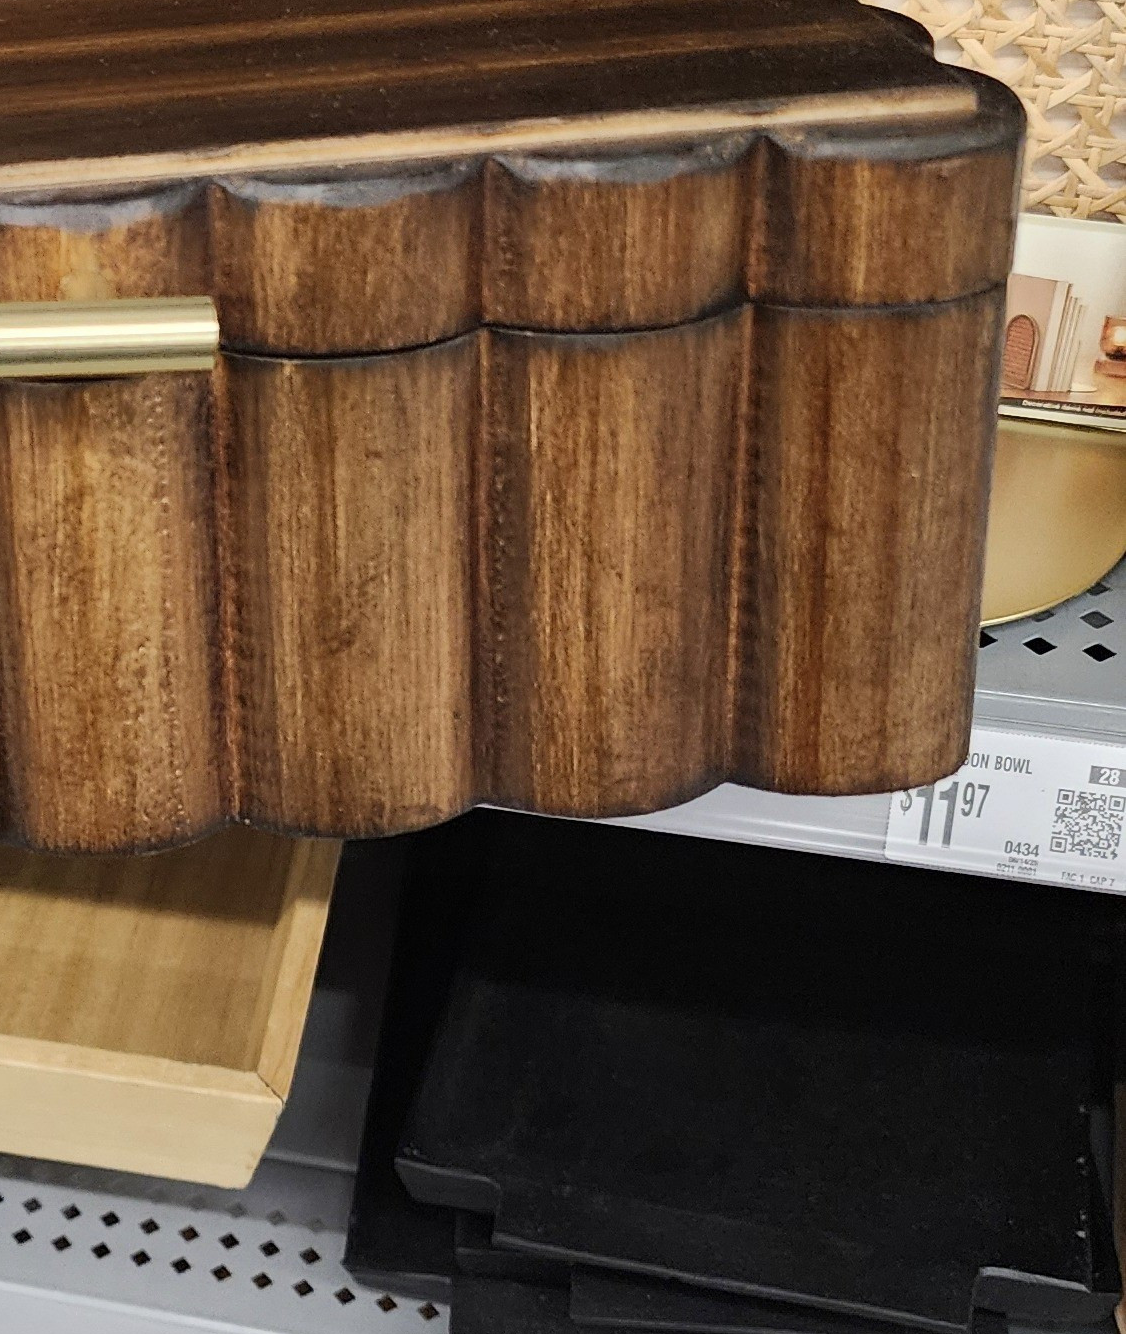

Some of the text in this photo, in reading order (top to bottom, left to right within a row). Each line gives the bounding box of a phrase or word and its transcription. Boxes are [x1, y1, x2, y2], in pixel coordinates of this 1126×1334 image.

[994, 755, 1033, 774] BOWL
[1099, 767, 1121, 785] 28
[1004, 840, 1040, 857] 0434
